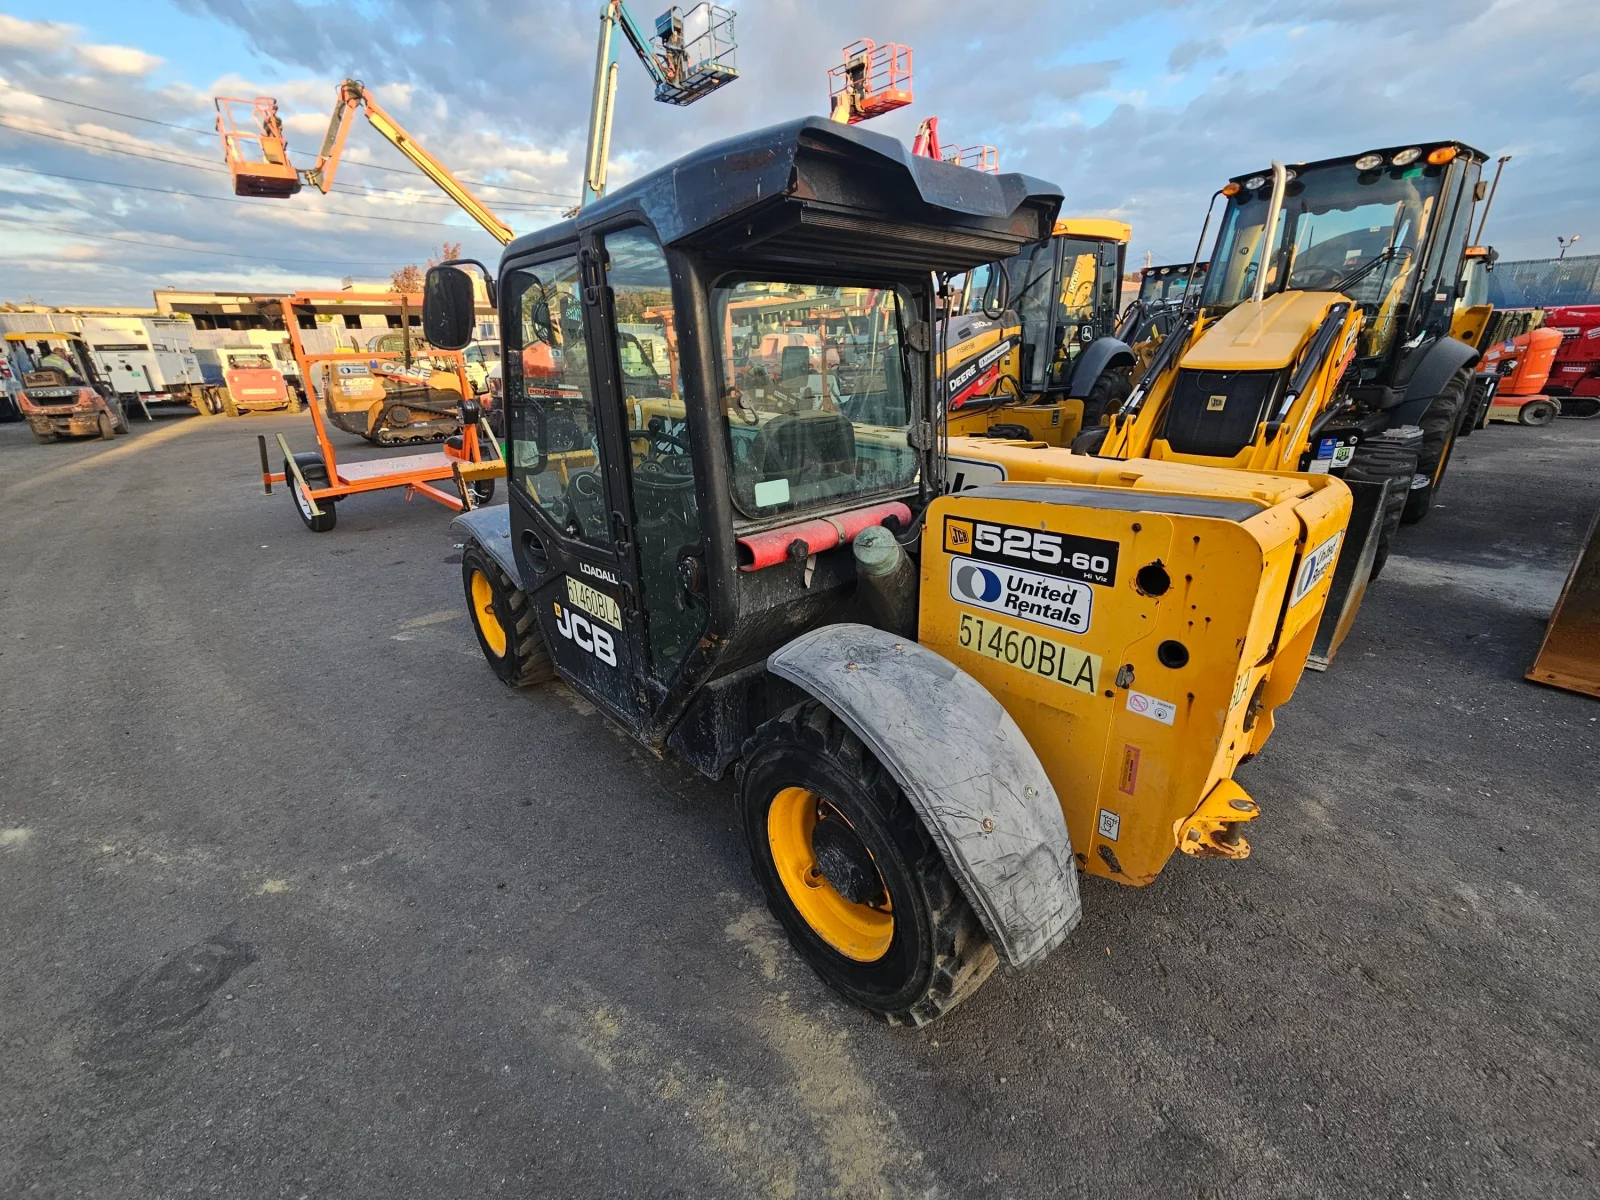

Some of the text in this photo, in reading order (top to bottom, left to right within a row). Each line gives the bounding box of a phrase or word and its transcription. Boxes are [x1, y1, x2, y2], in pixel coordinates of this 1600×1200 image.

[381, 362, 432, 379] CASE
[949, 364, 977, 392] DEERE
[952, 527, 969, 545] JCB
[579, 562, 619, 585] LOADALL
[1083, 572, 1108, 583] Hi Viz
[567, 579, 621, 625] 51460BLA
[1006, 575, 1079, 606] United
[1004, 592, 1082, 626] Rentals
[556, 607, 617, 668] JCB
[959, 613, 1095, 693] 51460BLA
